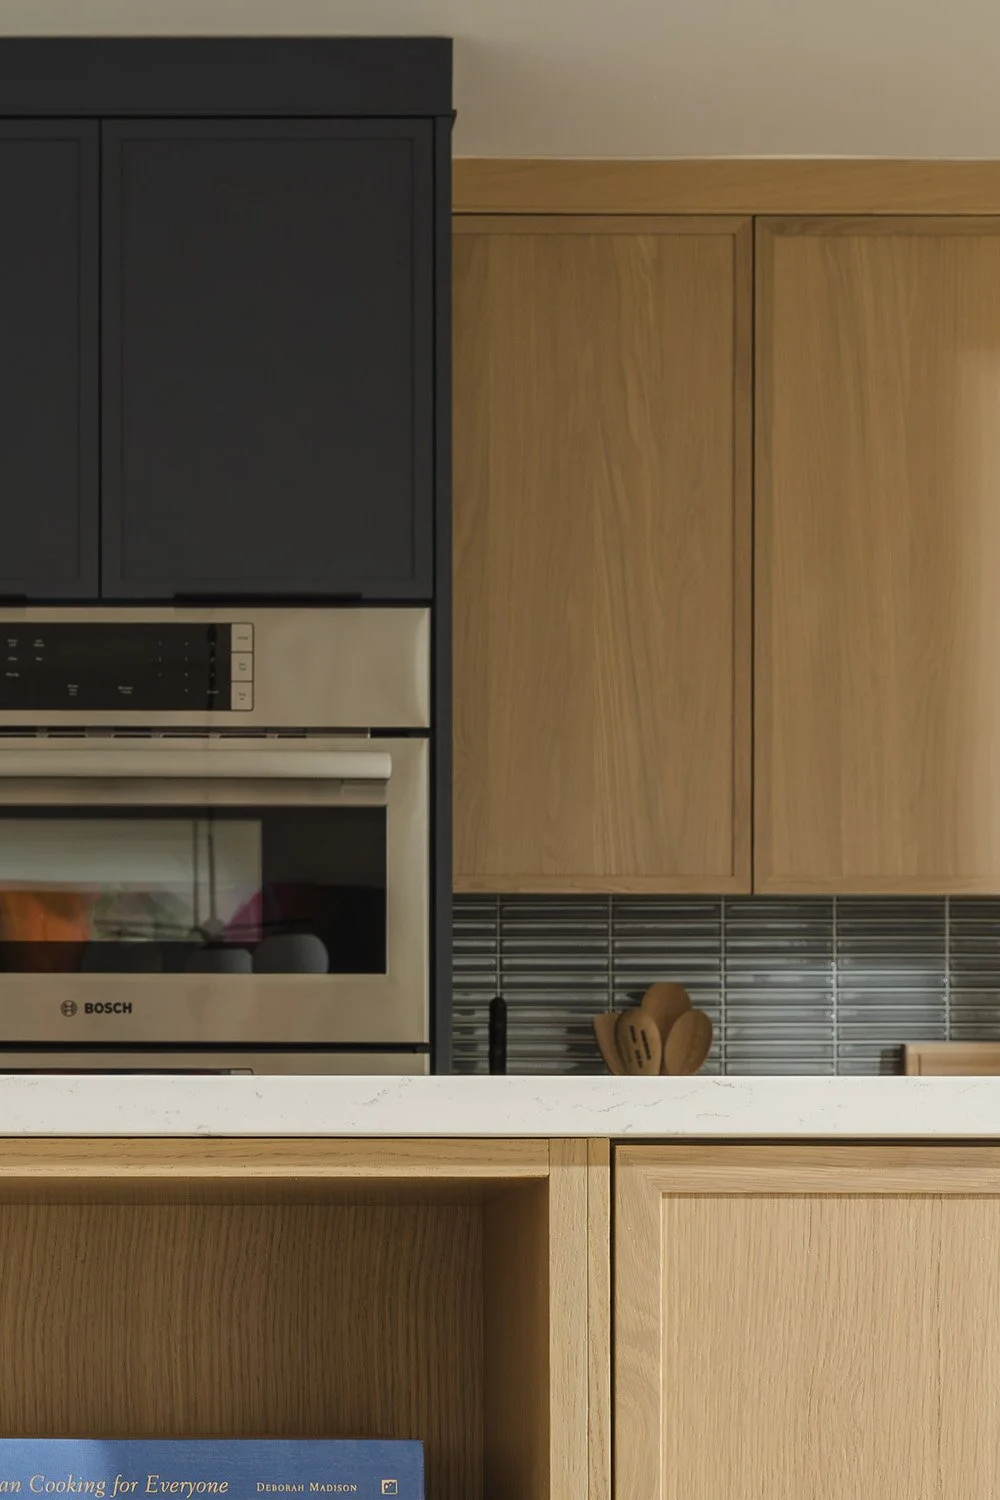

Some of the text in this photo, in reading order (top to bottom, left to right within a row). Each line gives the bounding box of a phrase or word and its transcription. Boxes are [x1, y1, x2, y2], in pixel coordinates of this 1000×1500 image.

[84, 1002, 133, 1014] BOSCH
[29, 1474, 106, 1497] Cooking
[110, 1474, 139, 1498] for
[145, 1474, 229, 1498] Everyone
[256, 1482, 357, 1492] DEBORAH MADISON
